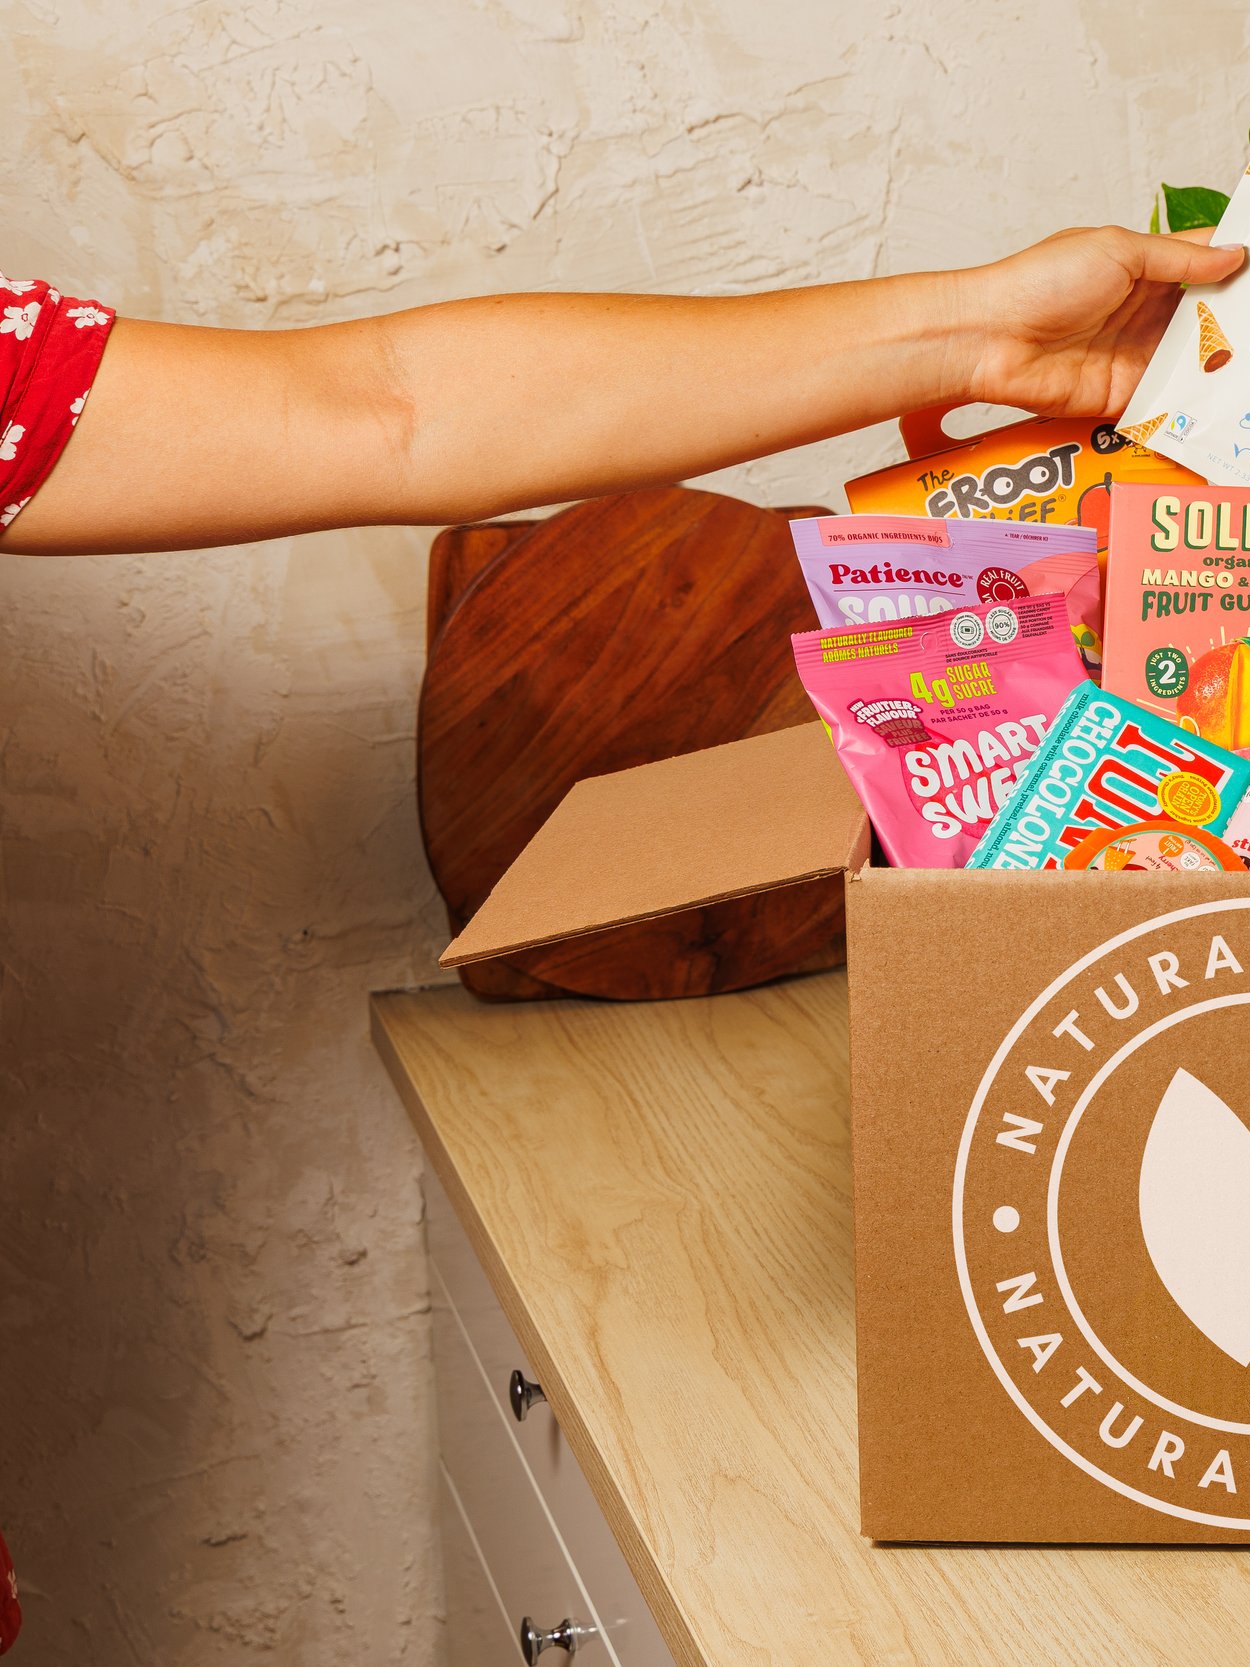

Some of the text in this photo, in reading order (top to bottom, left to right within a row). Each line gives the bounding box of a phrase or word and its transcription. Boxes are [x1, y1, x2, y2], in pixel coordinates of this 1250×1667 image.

[917, 468, 955, 492] The
[847, 532, 880, 541] ORGANIC
[881, 532, 926, 542] INGREDIENTS
[828, 561, 964, 588] Patience
[980, 568, 1026, 592] REAL FRUIT
[1141, 568, 1234, 588] MANGO
[1238, 577, 1249, 587] &
[997, 608, 1013, 618] SUGAR
[1141, 590, 1213, 622] FRUIT
[994, 620, 1010, 629] 90%
[819, 626, 913, 650] NATURALLY FLAVOURED
[822, 643, 899, 663] ARÔMES NATURELS
[1150, 651, 1182, 666] JUST TWO
[945, 662, 992, 683] SUGAR
[1158, 660, 1176, 684] 2
[909, 671, 956, 708] 4g
[952, 678, 997, 700] SUCRE
[1150, 676, 1186, 695] INGREDIENTS
[860, 700, 914, 719] FRUITIER
[940, 708, 955, 716] PER
[956, 706, 967, 714] 50
[974, 703, 991, 711] BAG
[1074, 692, 1089, 711] milk
[865, 710, 917, 727] FLAVOUR
[874, 718, 923, 736] SAVEUR
[931, 716, 946, 724] PAR
[947, 713, 977, 723] SACHET
[1054, 709, 1079, 745] chocolate
[886, 731, 931, 747] FRUITÉE
[892, 728, 913, 737] PLUS
[904, 713, 1047, 798] SMART
[1044, 744, 1059, 762] with
[1024, 760, 1048, 794] caramel,
[1038, 720, 1234, 870] TON
[1171, 781, 1190, 807] CHAIN
[1180, 786, 1200, 814] OPEN
[1006, 793, 1028, 822] pretzel,
[988, 821, 1012, 852] almond,
[995, 934, 1245, 1155] NATURA
[996, 1271, 1239, 1494] NATURA
